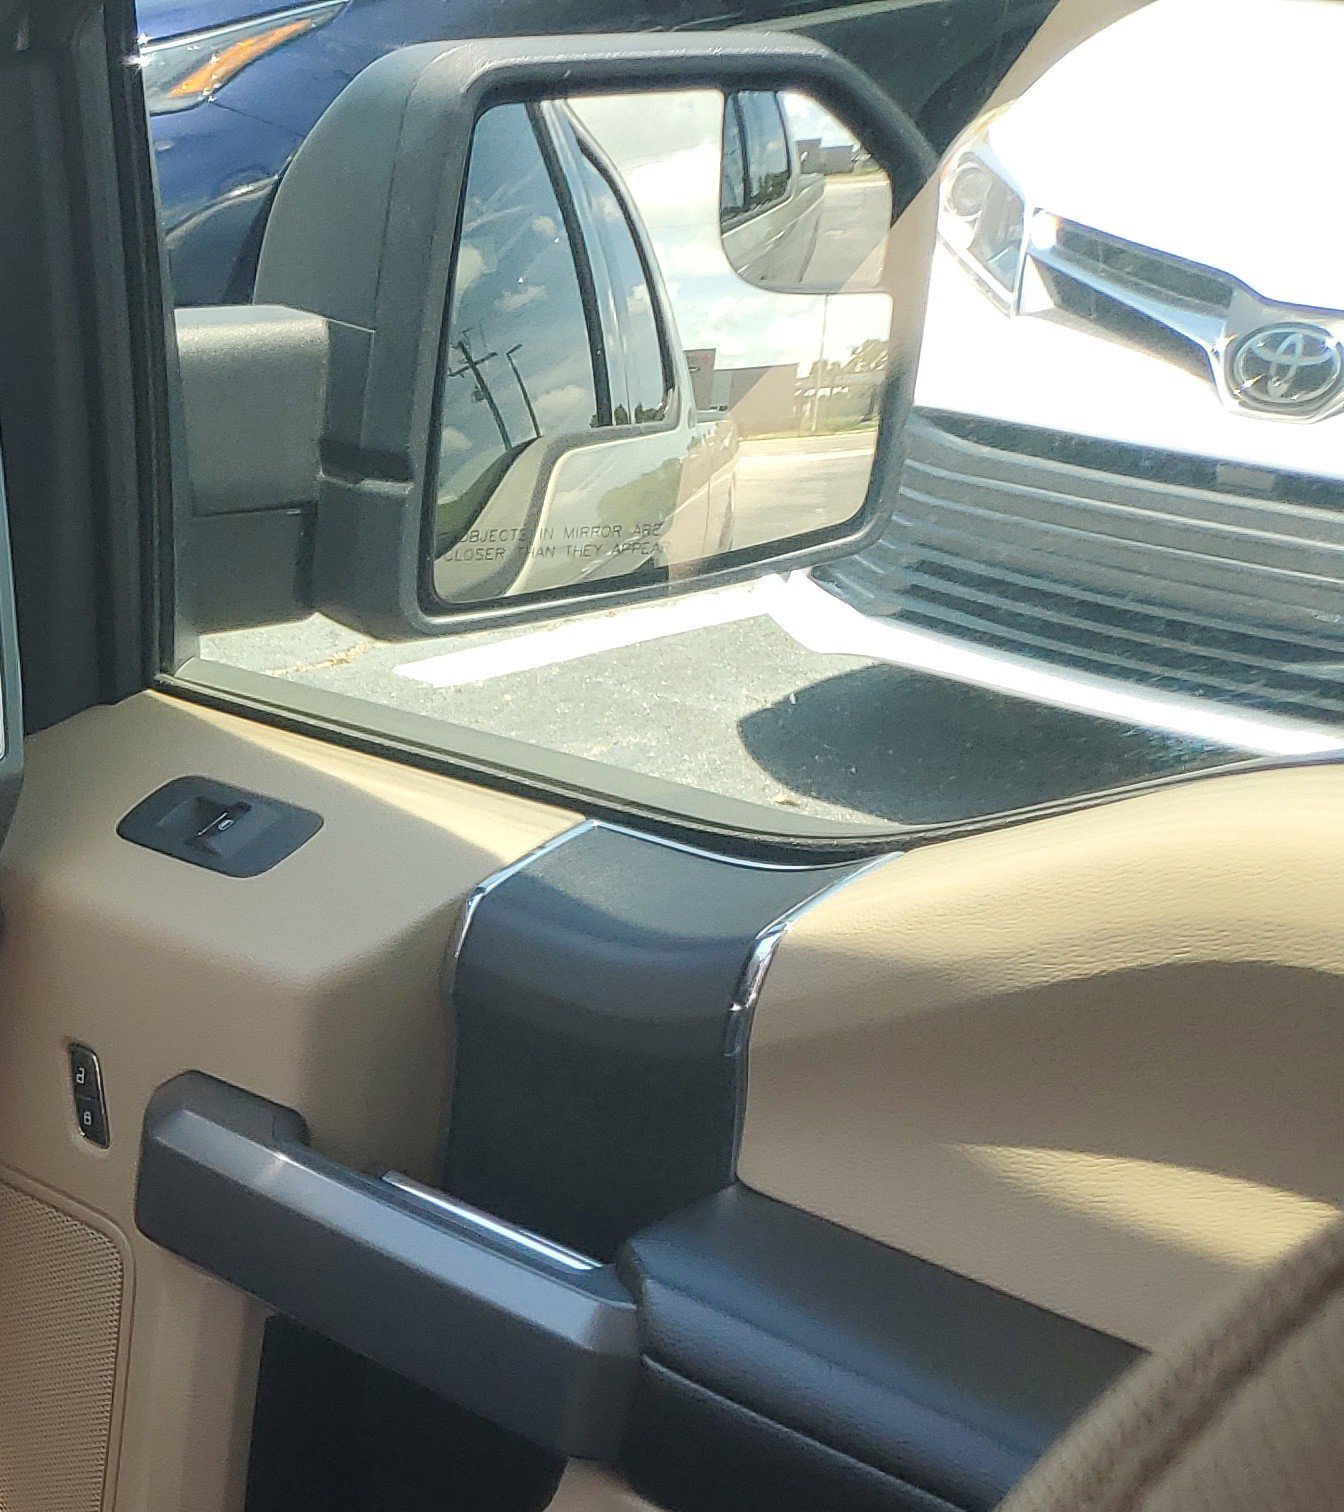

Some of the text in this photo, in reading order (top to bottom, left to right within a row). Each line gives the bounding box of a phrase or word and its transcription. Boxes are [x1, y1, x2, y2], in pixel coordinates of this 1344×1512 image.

[539, 526, 554, 540] IN
[563, 524, 622, 539] MIRROR
[633, 522, 662, 537] ARE
[444, 546, 506, 562] CLOSER
[565, 544, 600, 558] THEY
